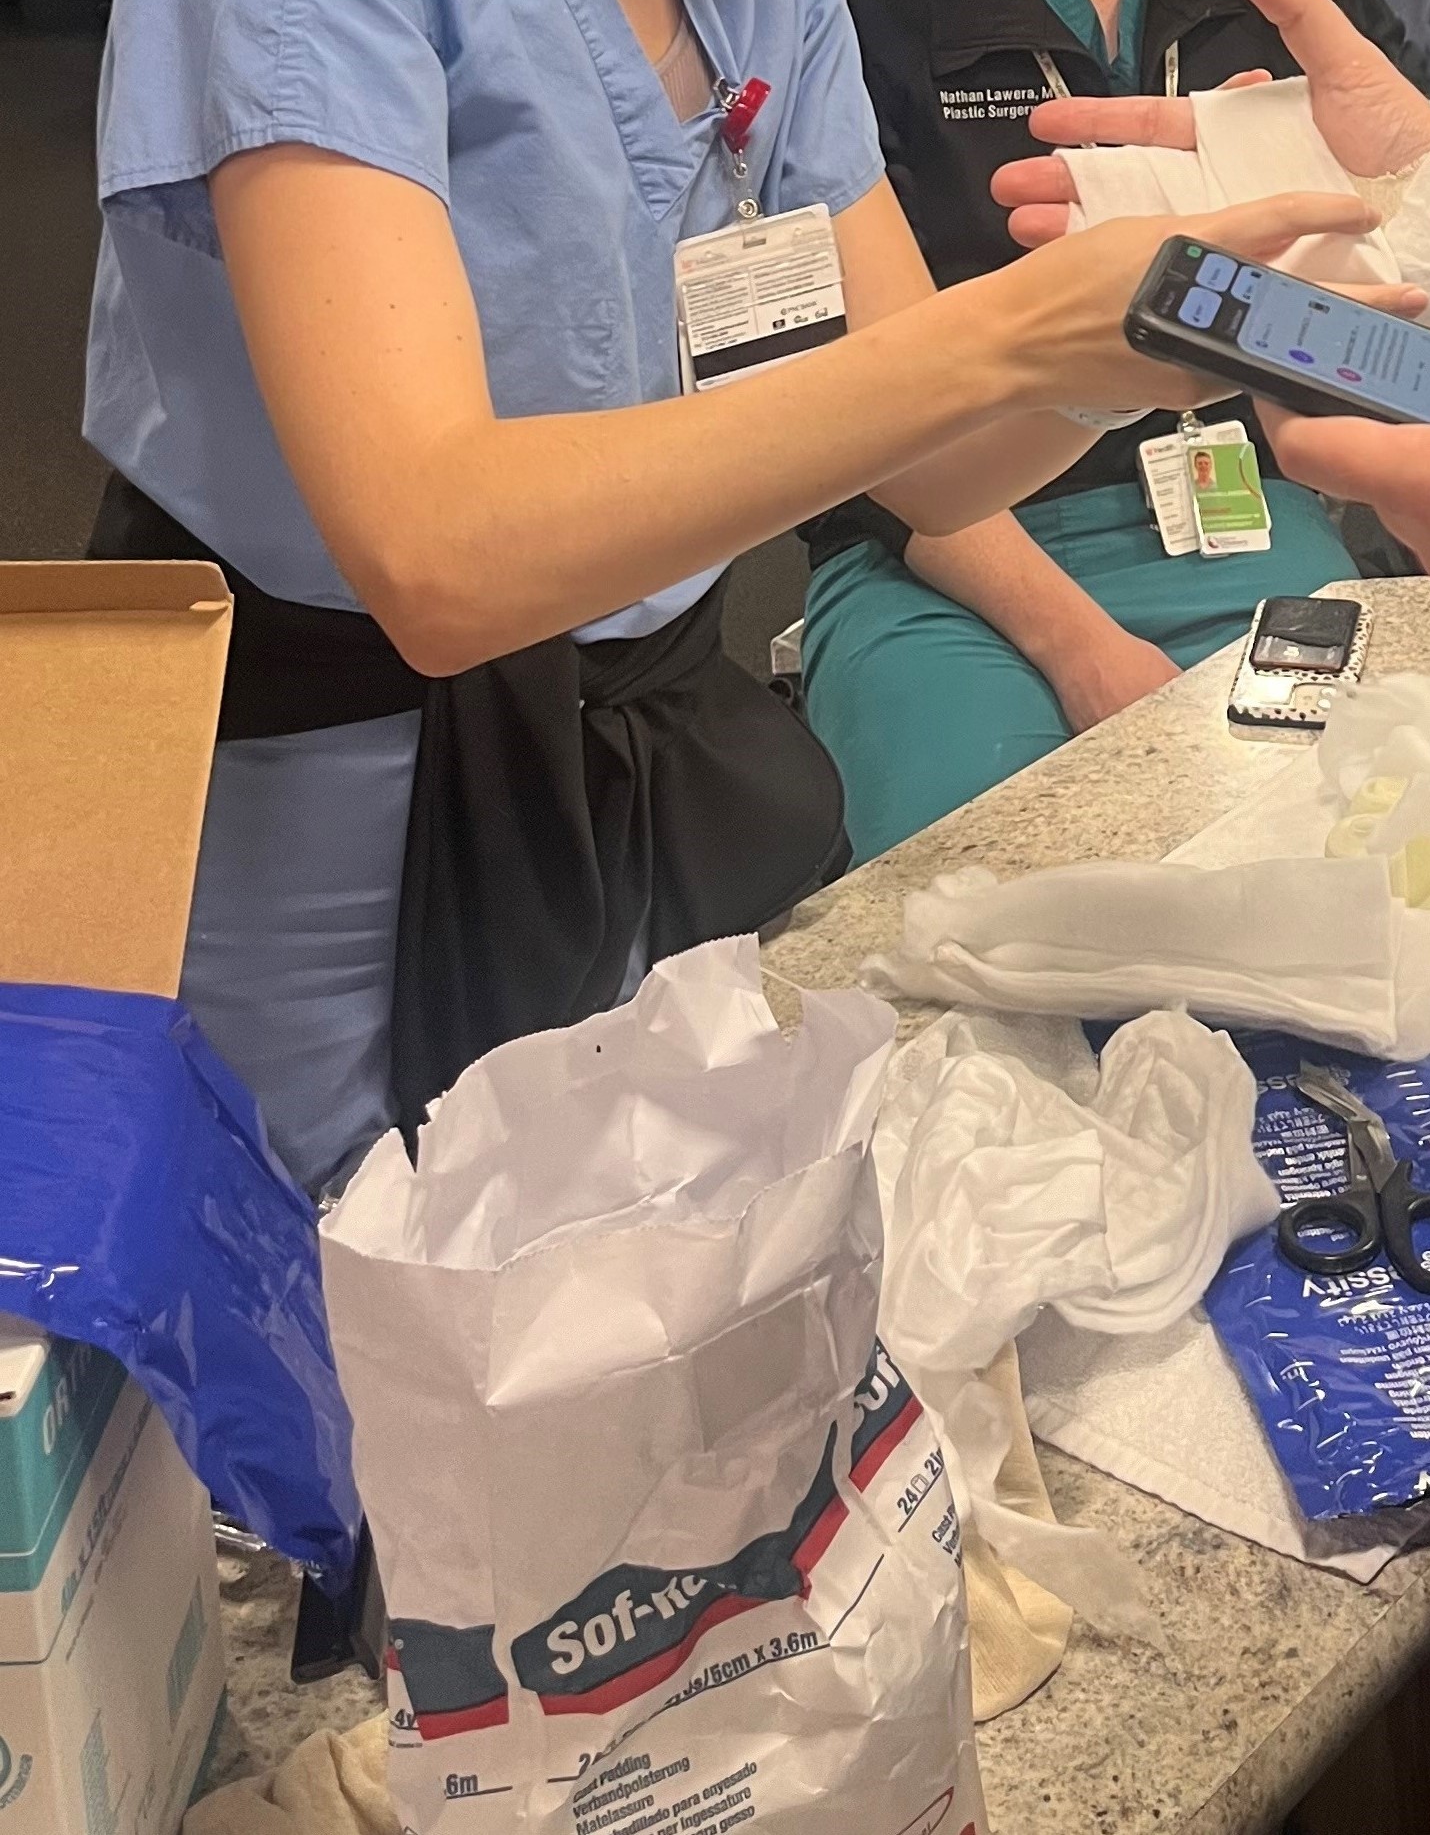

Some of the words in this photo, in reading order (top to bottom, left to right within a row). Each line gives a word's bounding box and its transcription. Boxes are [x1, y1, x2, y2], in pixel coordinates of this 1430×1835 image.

[940, 89, 984, 104] Nathan
[986, 87, 1039, 103] Lawera,
[943, 105, 986, 120] Plastic
[897, 1488, 920, 1516] 24
[769, 1631, 820, 1659] 3.6m
